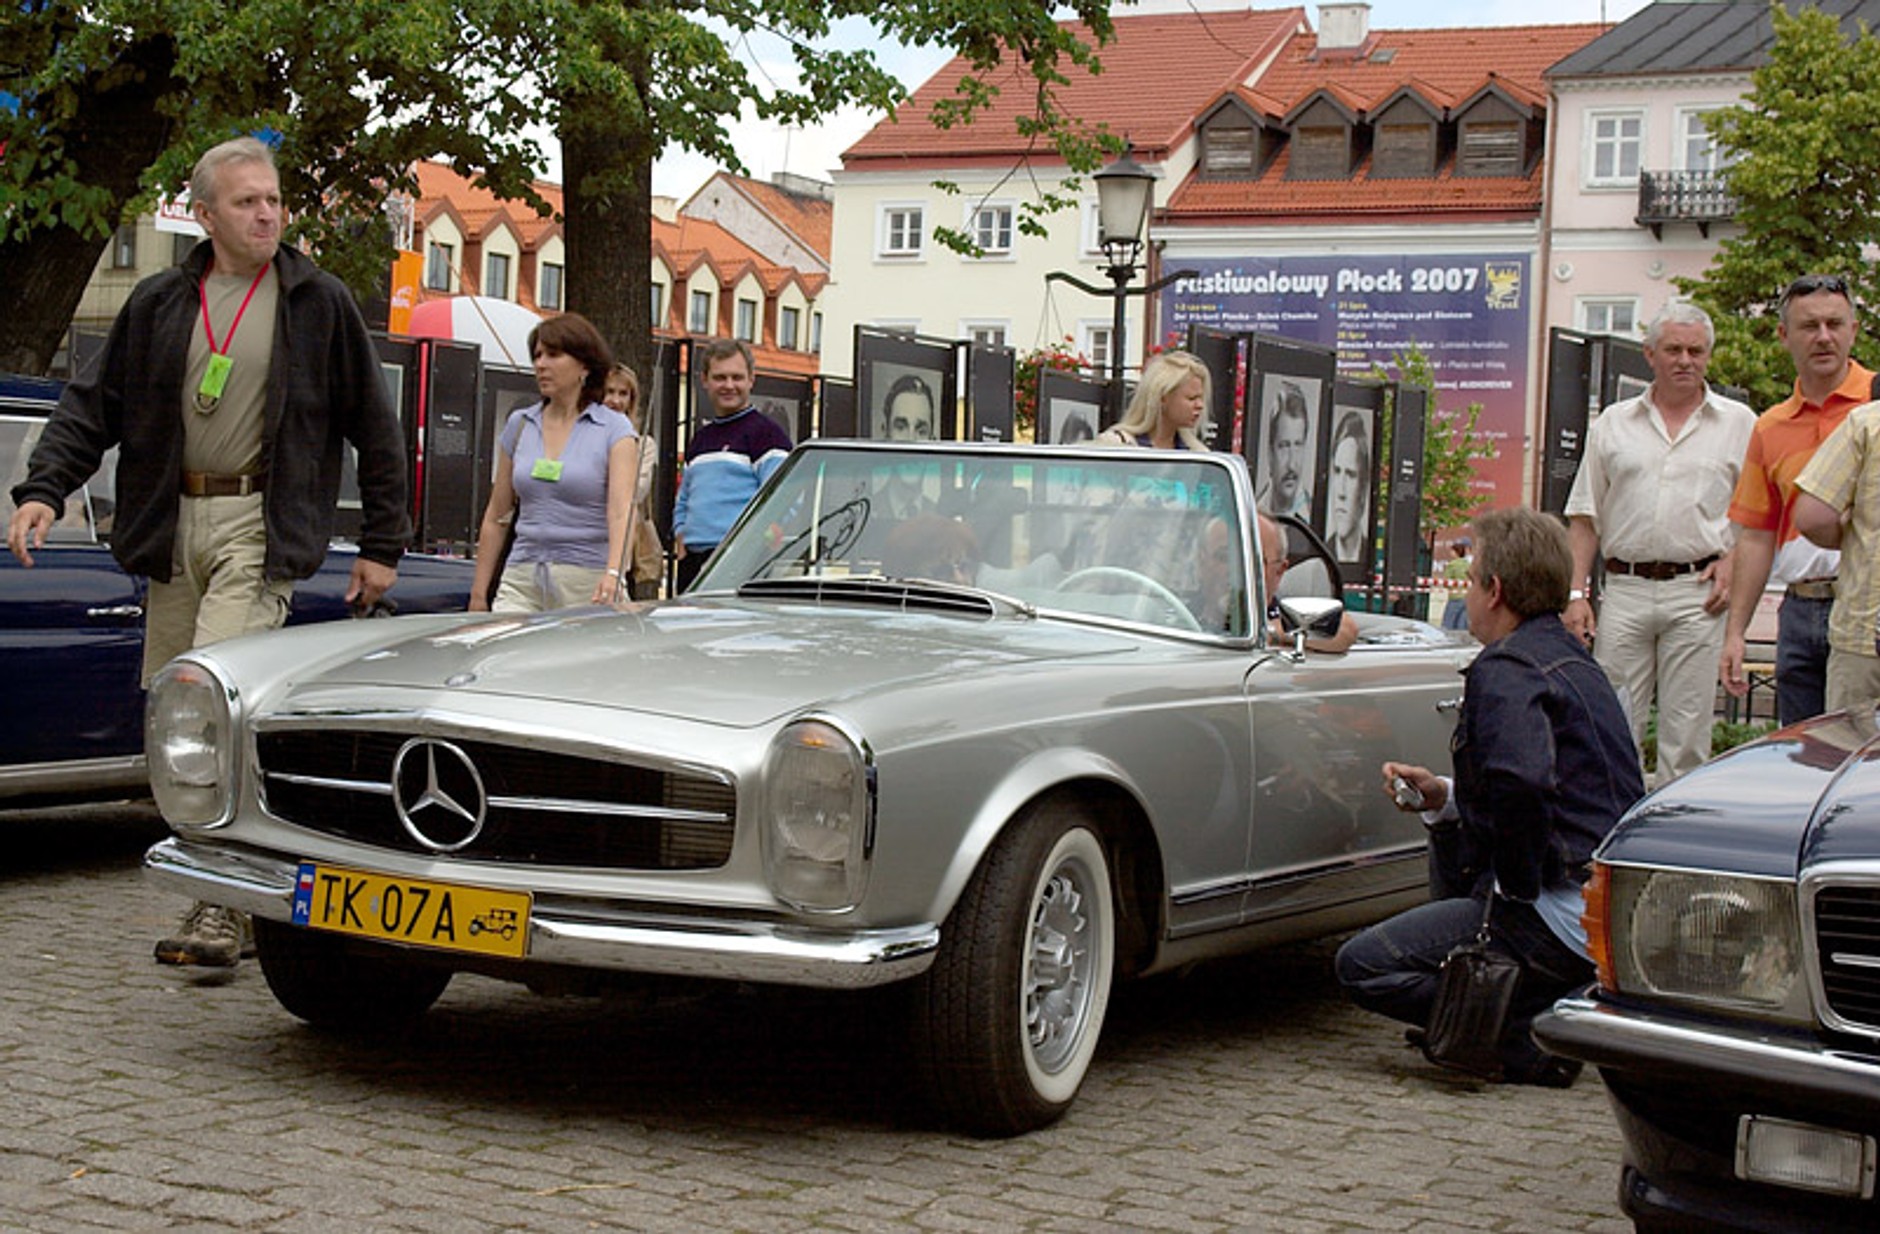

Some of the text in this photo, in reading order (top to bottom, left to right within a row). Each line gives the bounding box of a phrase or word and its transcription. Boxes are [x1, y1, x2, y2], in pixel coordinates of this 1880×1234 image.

[1336, 267, 1402, 293] Płock
[1410, 267, 1479, 292] 2007
[296, 899, 309, 916] PL
[320, 873, 455, 942] TK 07A
